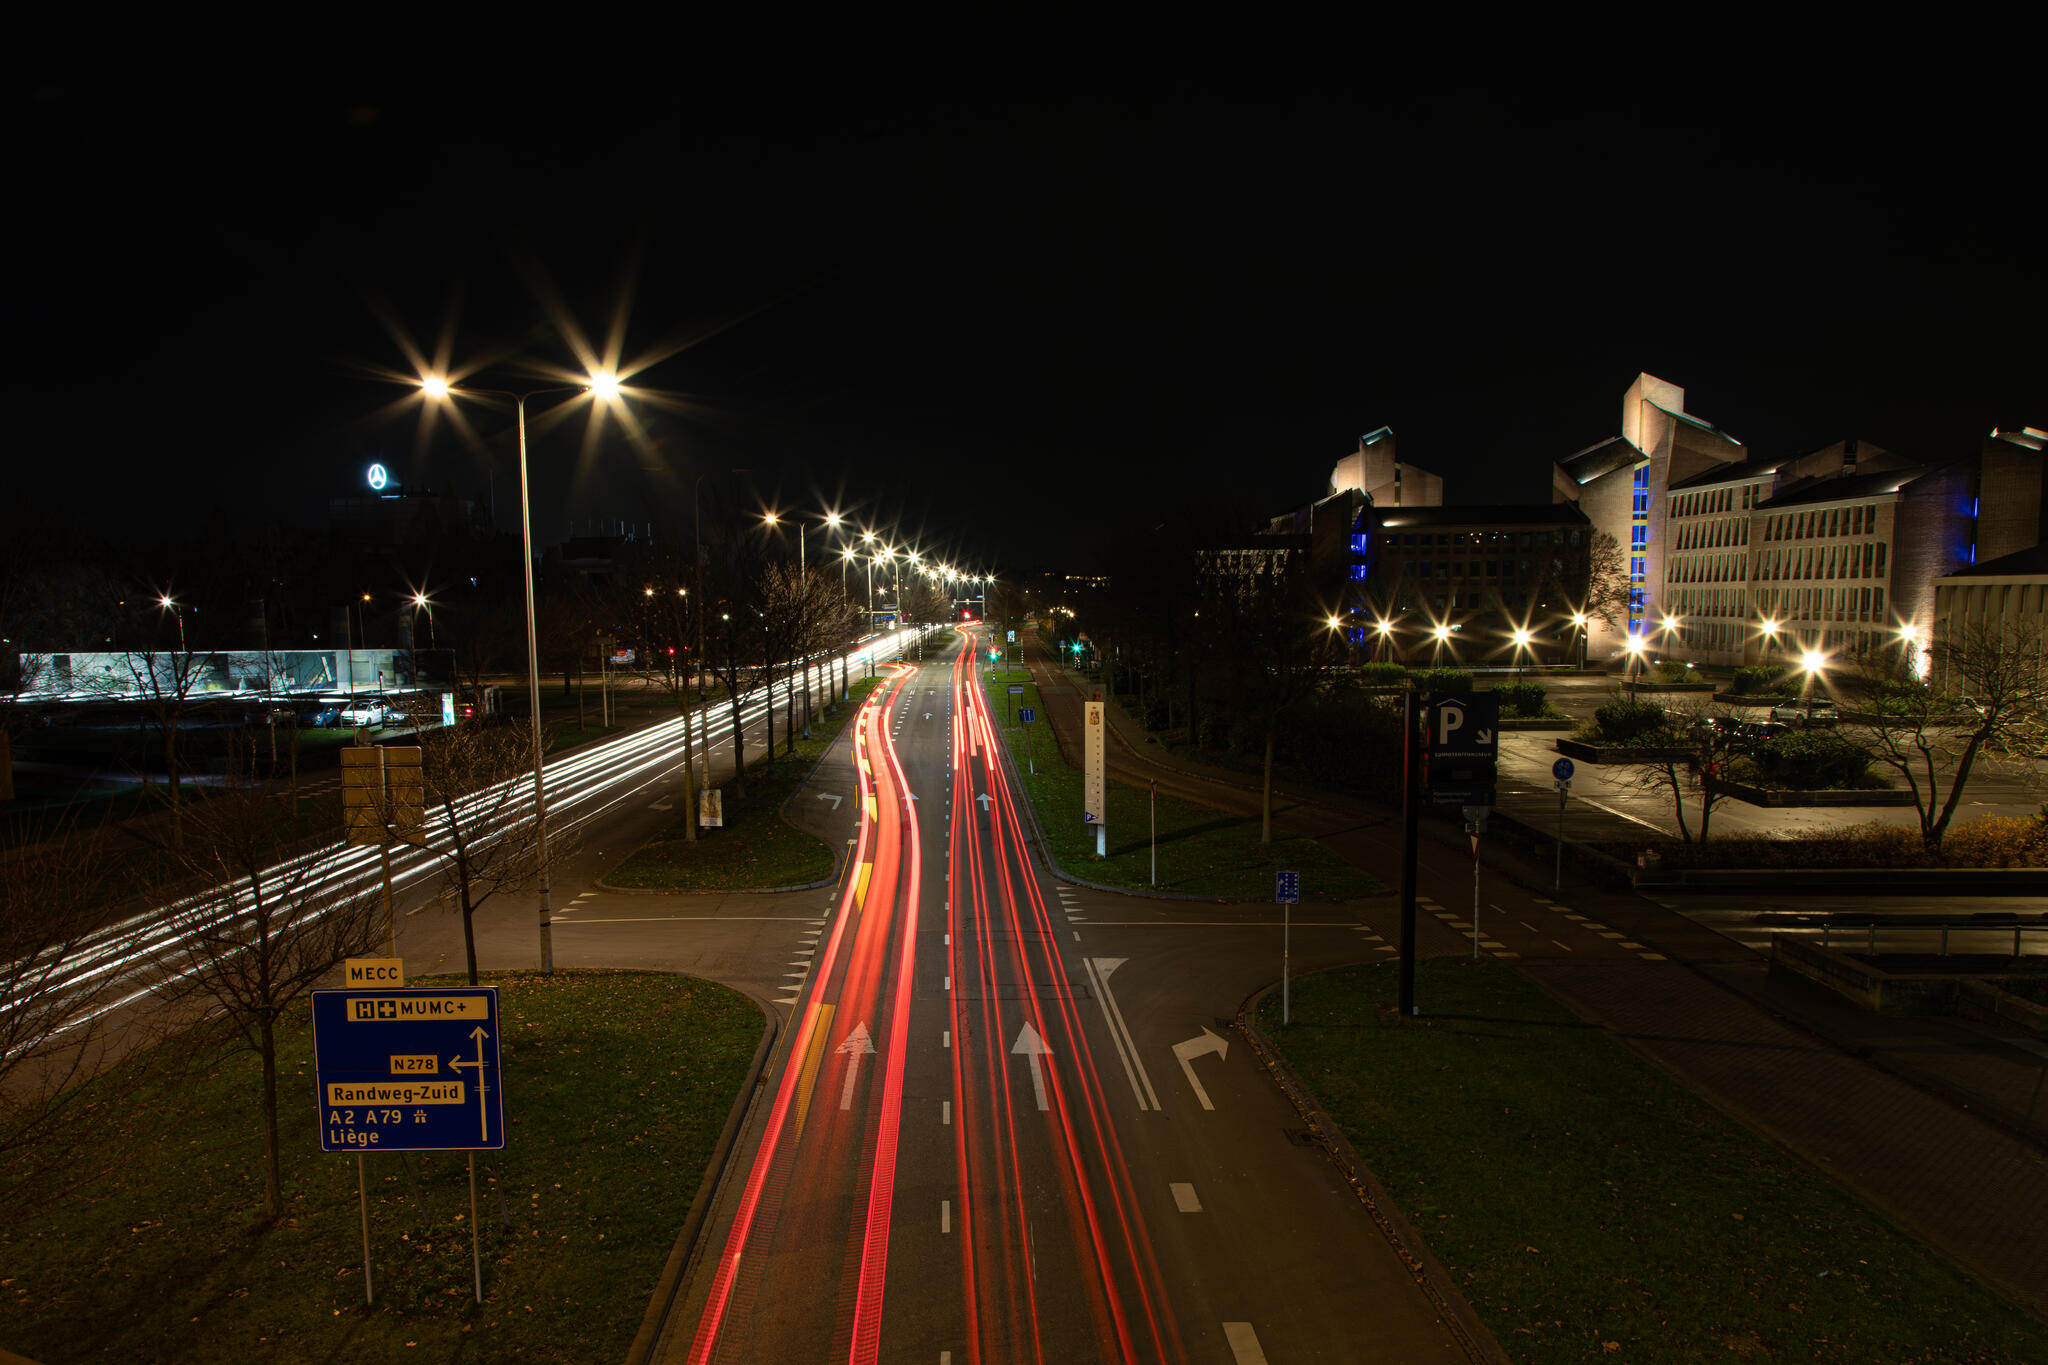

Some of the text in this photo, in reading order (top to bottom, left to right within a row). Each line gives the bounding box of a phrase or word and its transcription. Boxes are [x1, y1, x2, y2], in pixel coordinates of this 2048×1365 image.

[1439, 706, 1465, 745] P
[351, 967, 398, 980] MECC
[401, 1001, 466, 1015] MUMC+
[394, 1059, 434, 1070] N278
[334, 1086, 459, 1102] Randweg-Zuid
[329, 1109, 402, 1125] A2 A79
[330, 1129, 380, 1146] Liège
